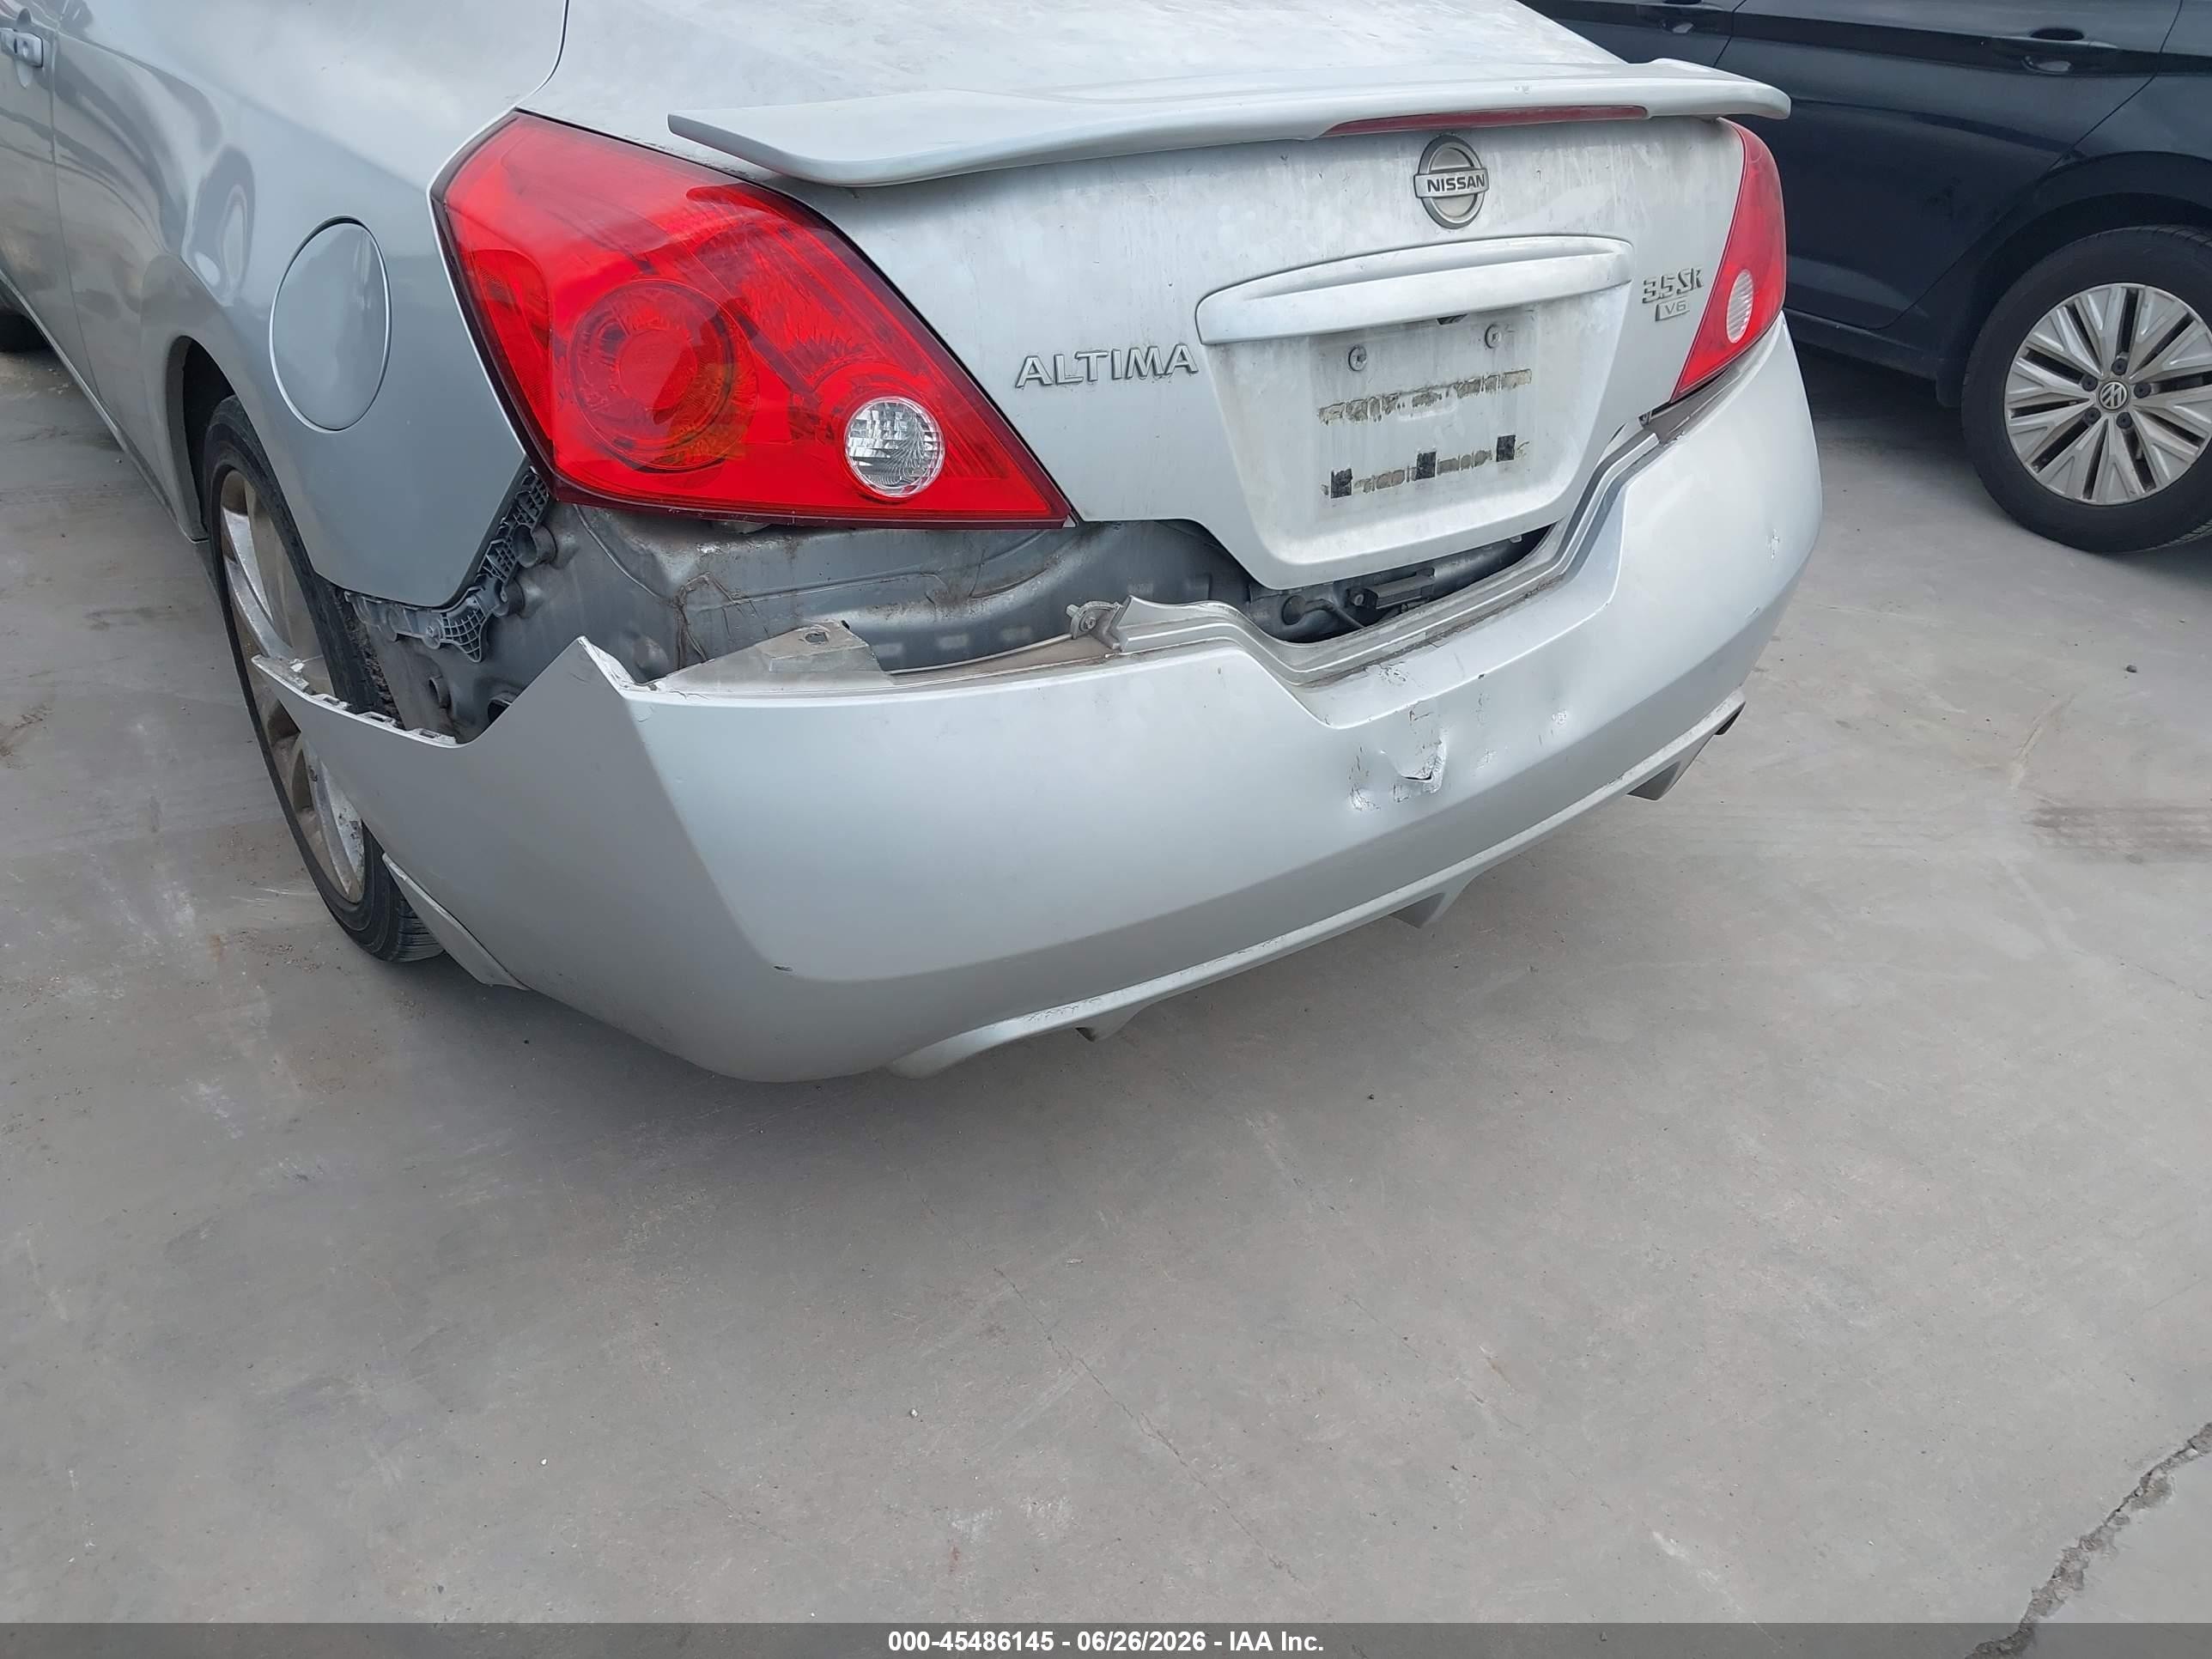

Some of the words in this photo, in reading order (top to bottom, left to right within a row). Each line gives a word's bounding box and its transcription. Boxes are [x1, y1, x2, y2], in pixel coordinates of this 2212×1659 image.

[1426, 173, 1486, 193] NISSAN
[1664, 300, 1686, 315] V6
[1014, 343, 1199, 389] ALTIMA
